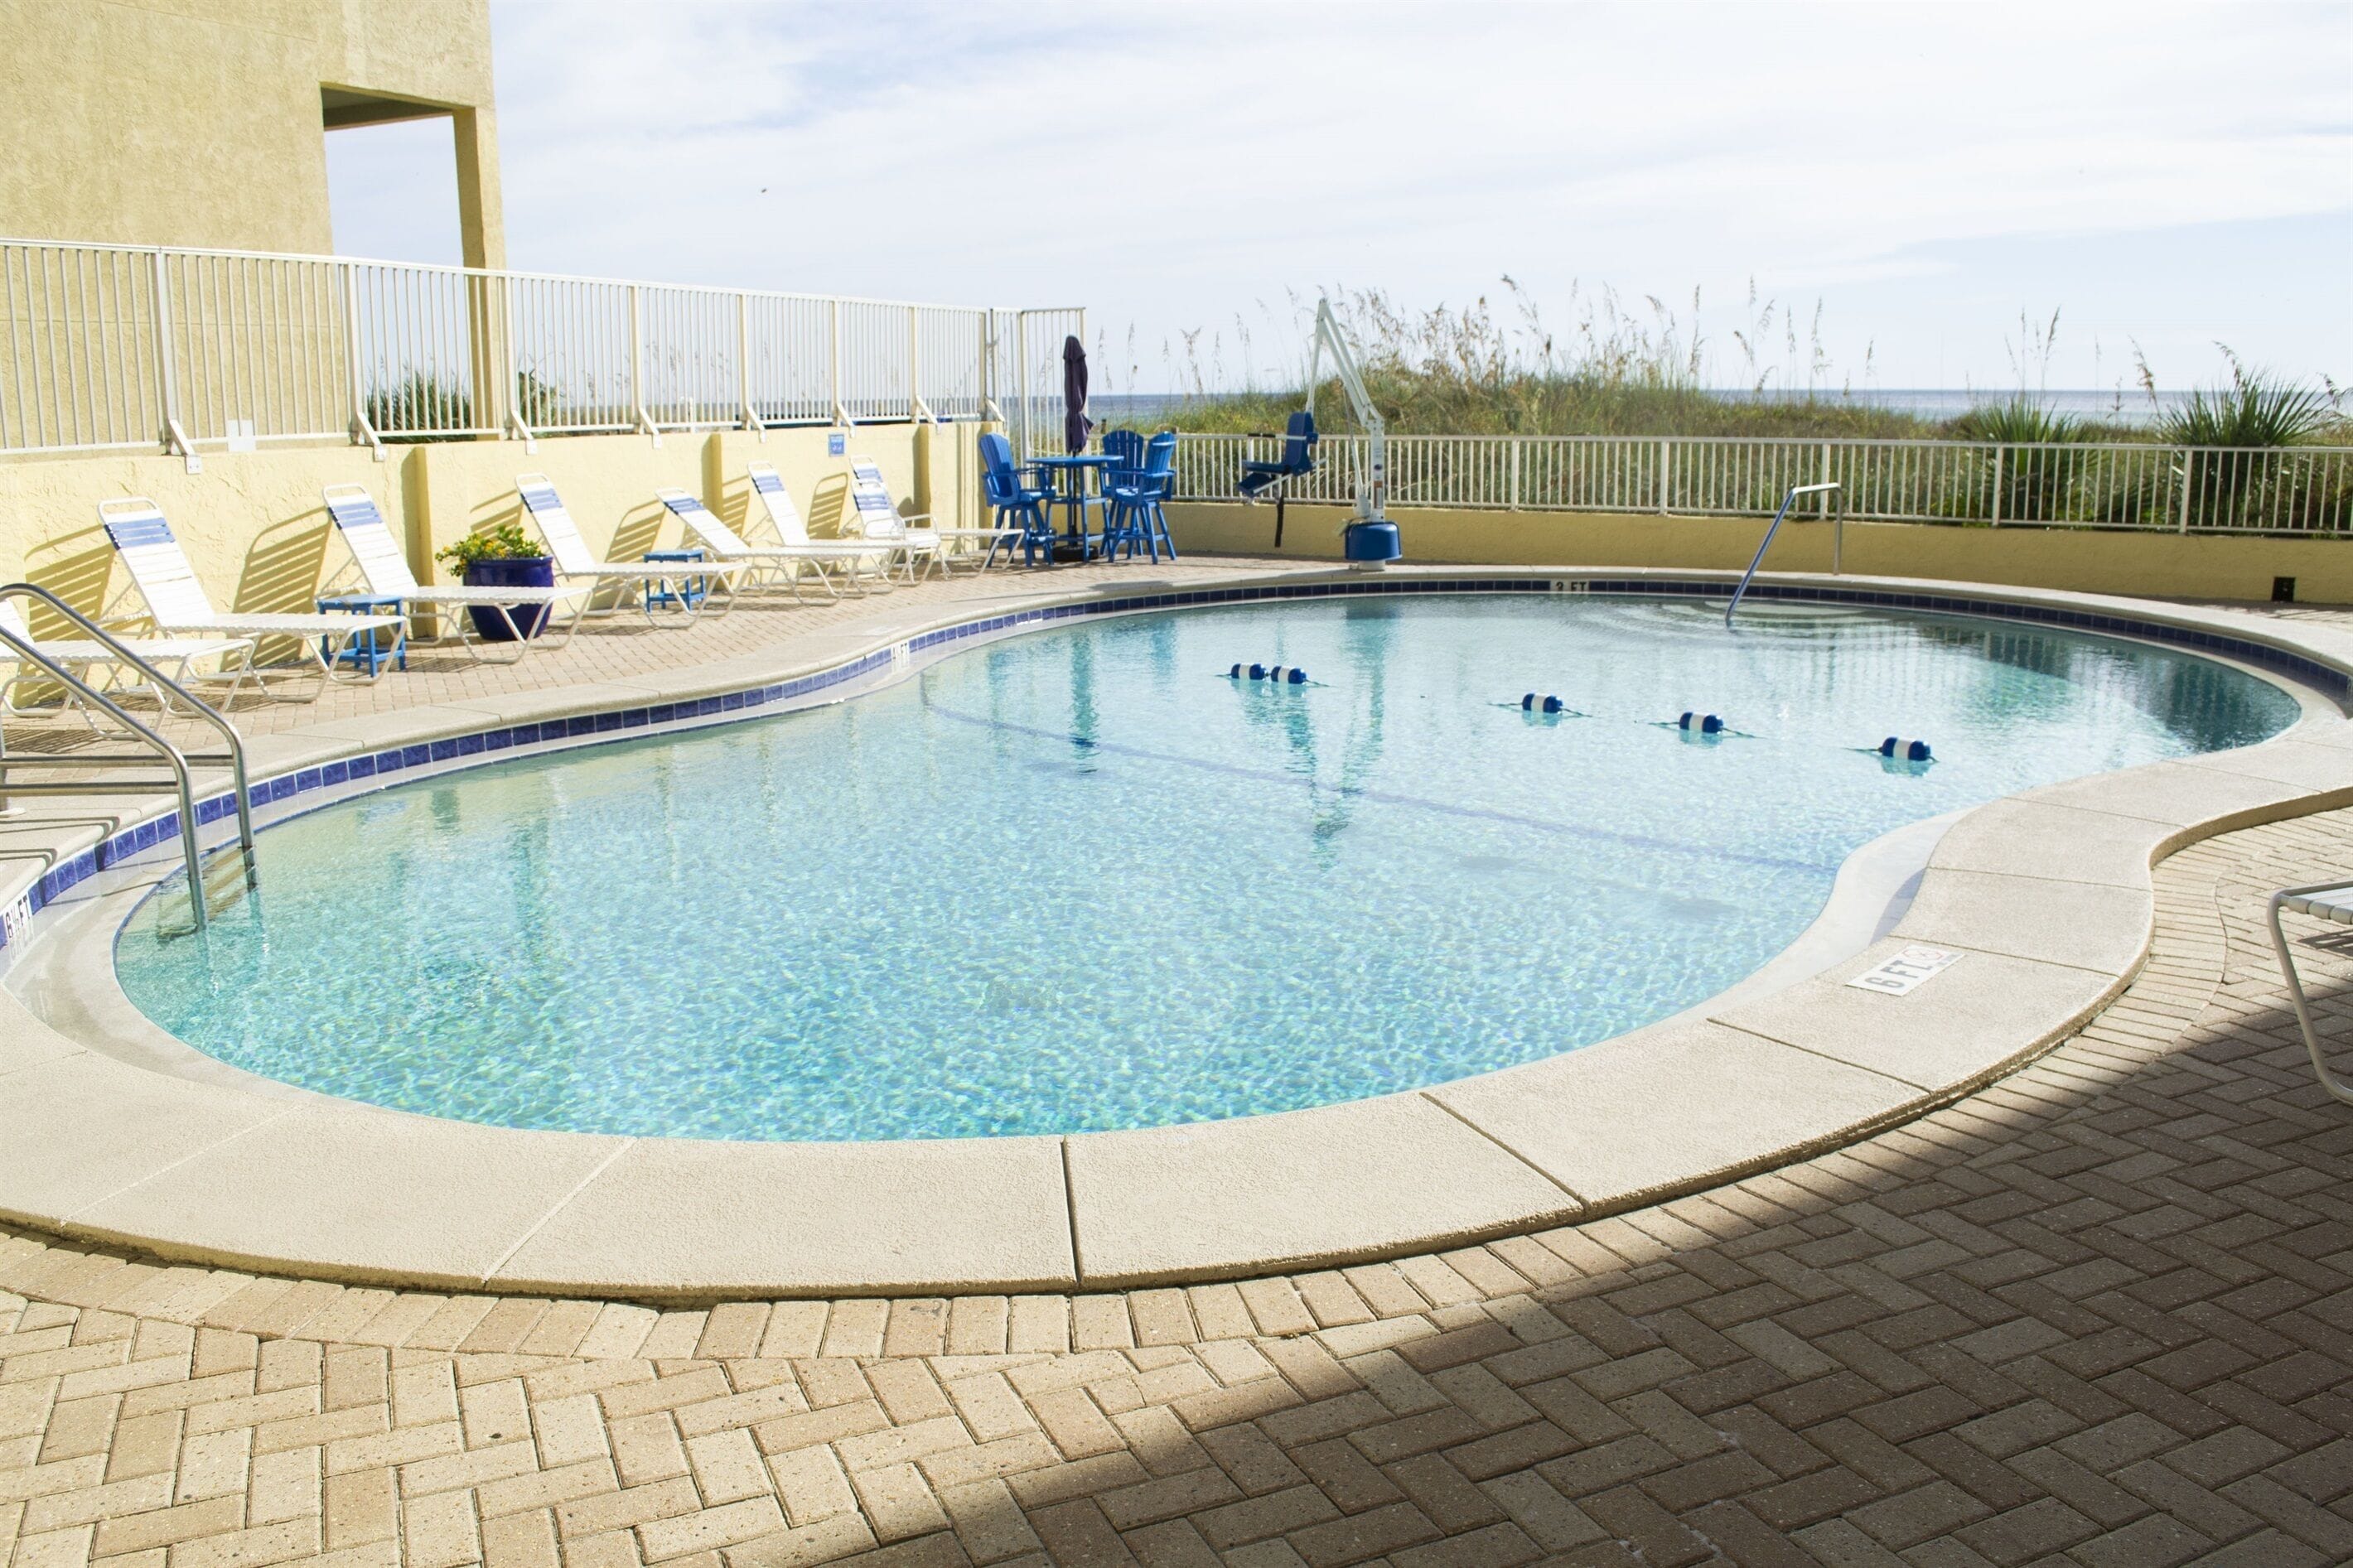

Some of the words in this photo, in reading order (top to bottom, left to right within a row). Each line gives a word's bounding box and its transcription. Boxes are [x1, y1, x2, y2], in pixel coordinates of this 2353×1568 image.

[1571, 581, 1587, 591] FT
[17, 894, 30, 927] FT
[1880, 960, 1934, 978] FT
[1864, 977, 1906, 988] 6
